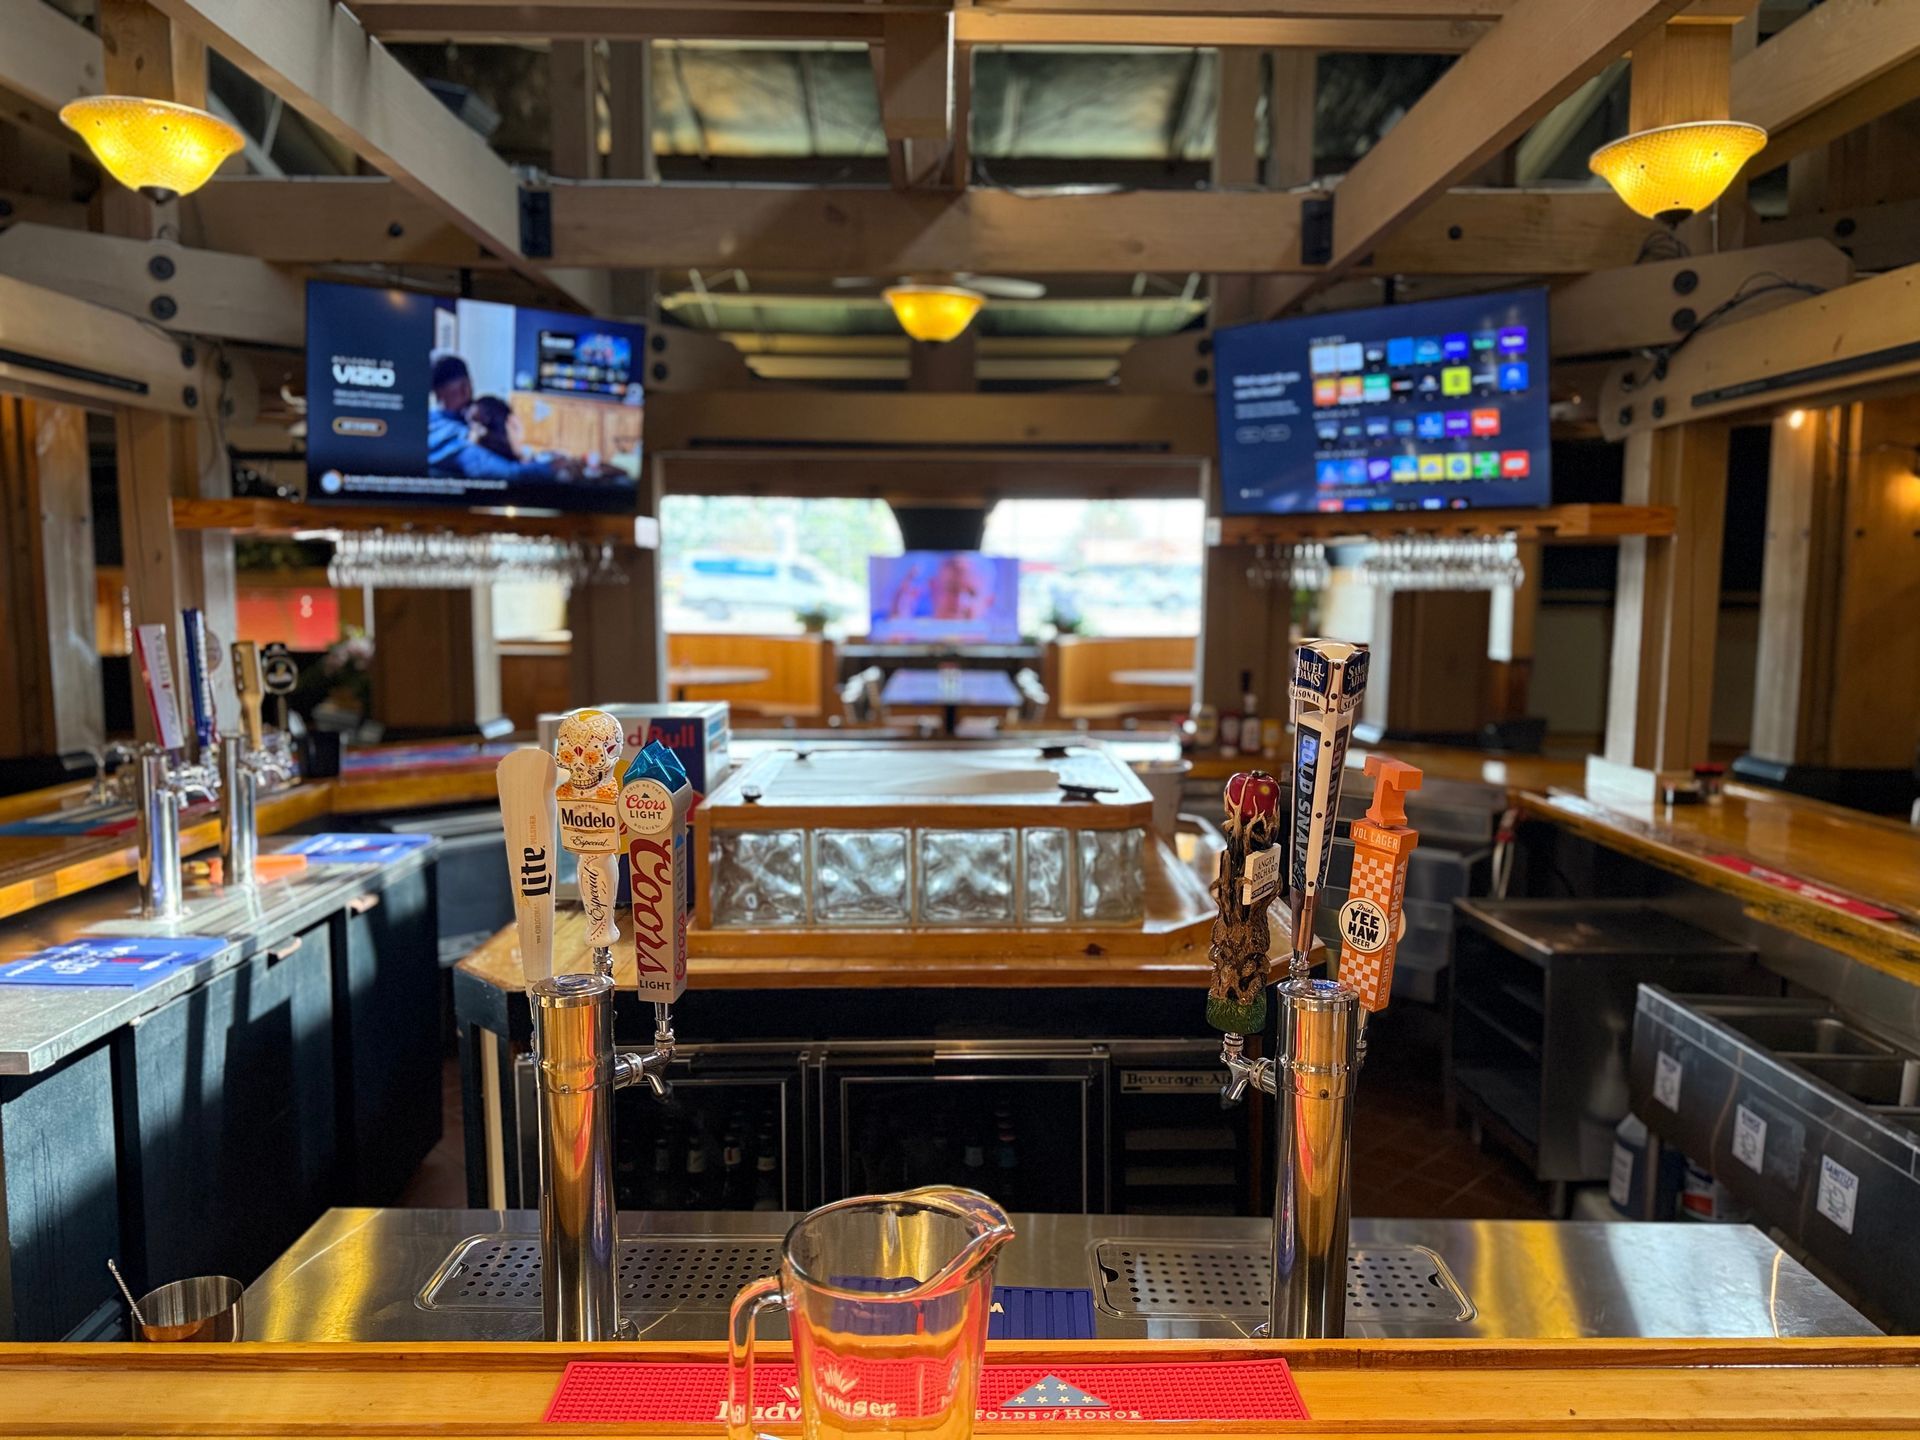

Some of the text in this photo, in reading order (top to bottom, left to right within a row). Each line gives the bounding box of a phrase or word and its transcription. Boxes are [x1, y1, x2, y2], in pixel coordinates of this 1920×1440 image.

[625, 794, 667, 811] Coors
[1296, 734, 1316, 862] COLD SNAP
[1321, 736, 1344, 861] COLD SNAP
[561, 807, 616, 828] Modelo
[629, 810, 662, 820] LIGHT
[570, 835, 609, 847] Especial
[1353, 825, 1399, 850] VOL LAGER
[520, 846, 553, 897] Lite
[583, 865, 608, 925] Especial
[629, 838, 672, 977] Coors
[674, 849, 686, 980] Coors LIGHT
[1349, 907, 1380, 930] YEE
[1357, 902, 1375, 915] Drink
[1347, 921, 1379, 944] HAW
[1352, 937, 1370, 949] BEER
[640, 980, 671, 991] LIGHT
[975, 1408, 1142, 1421] FOLDS of HONOR
